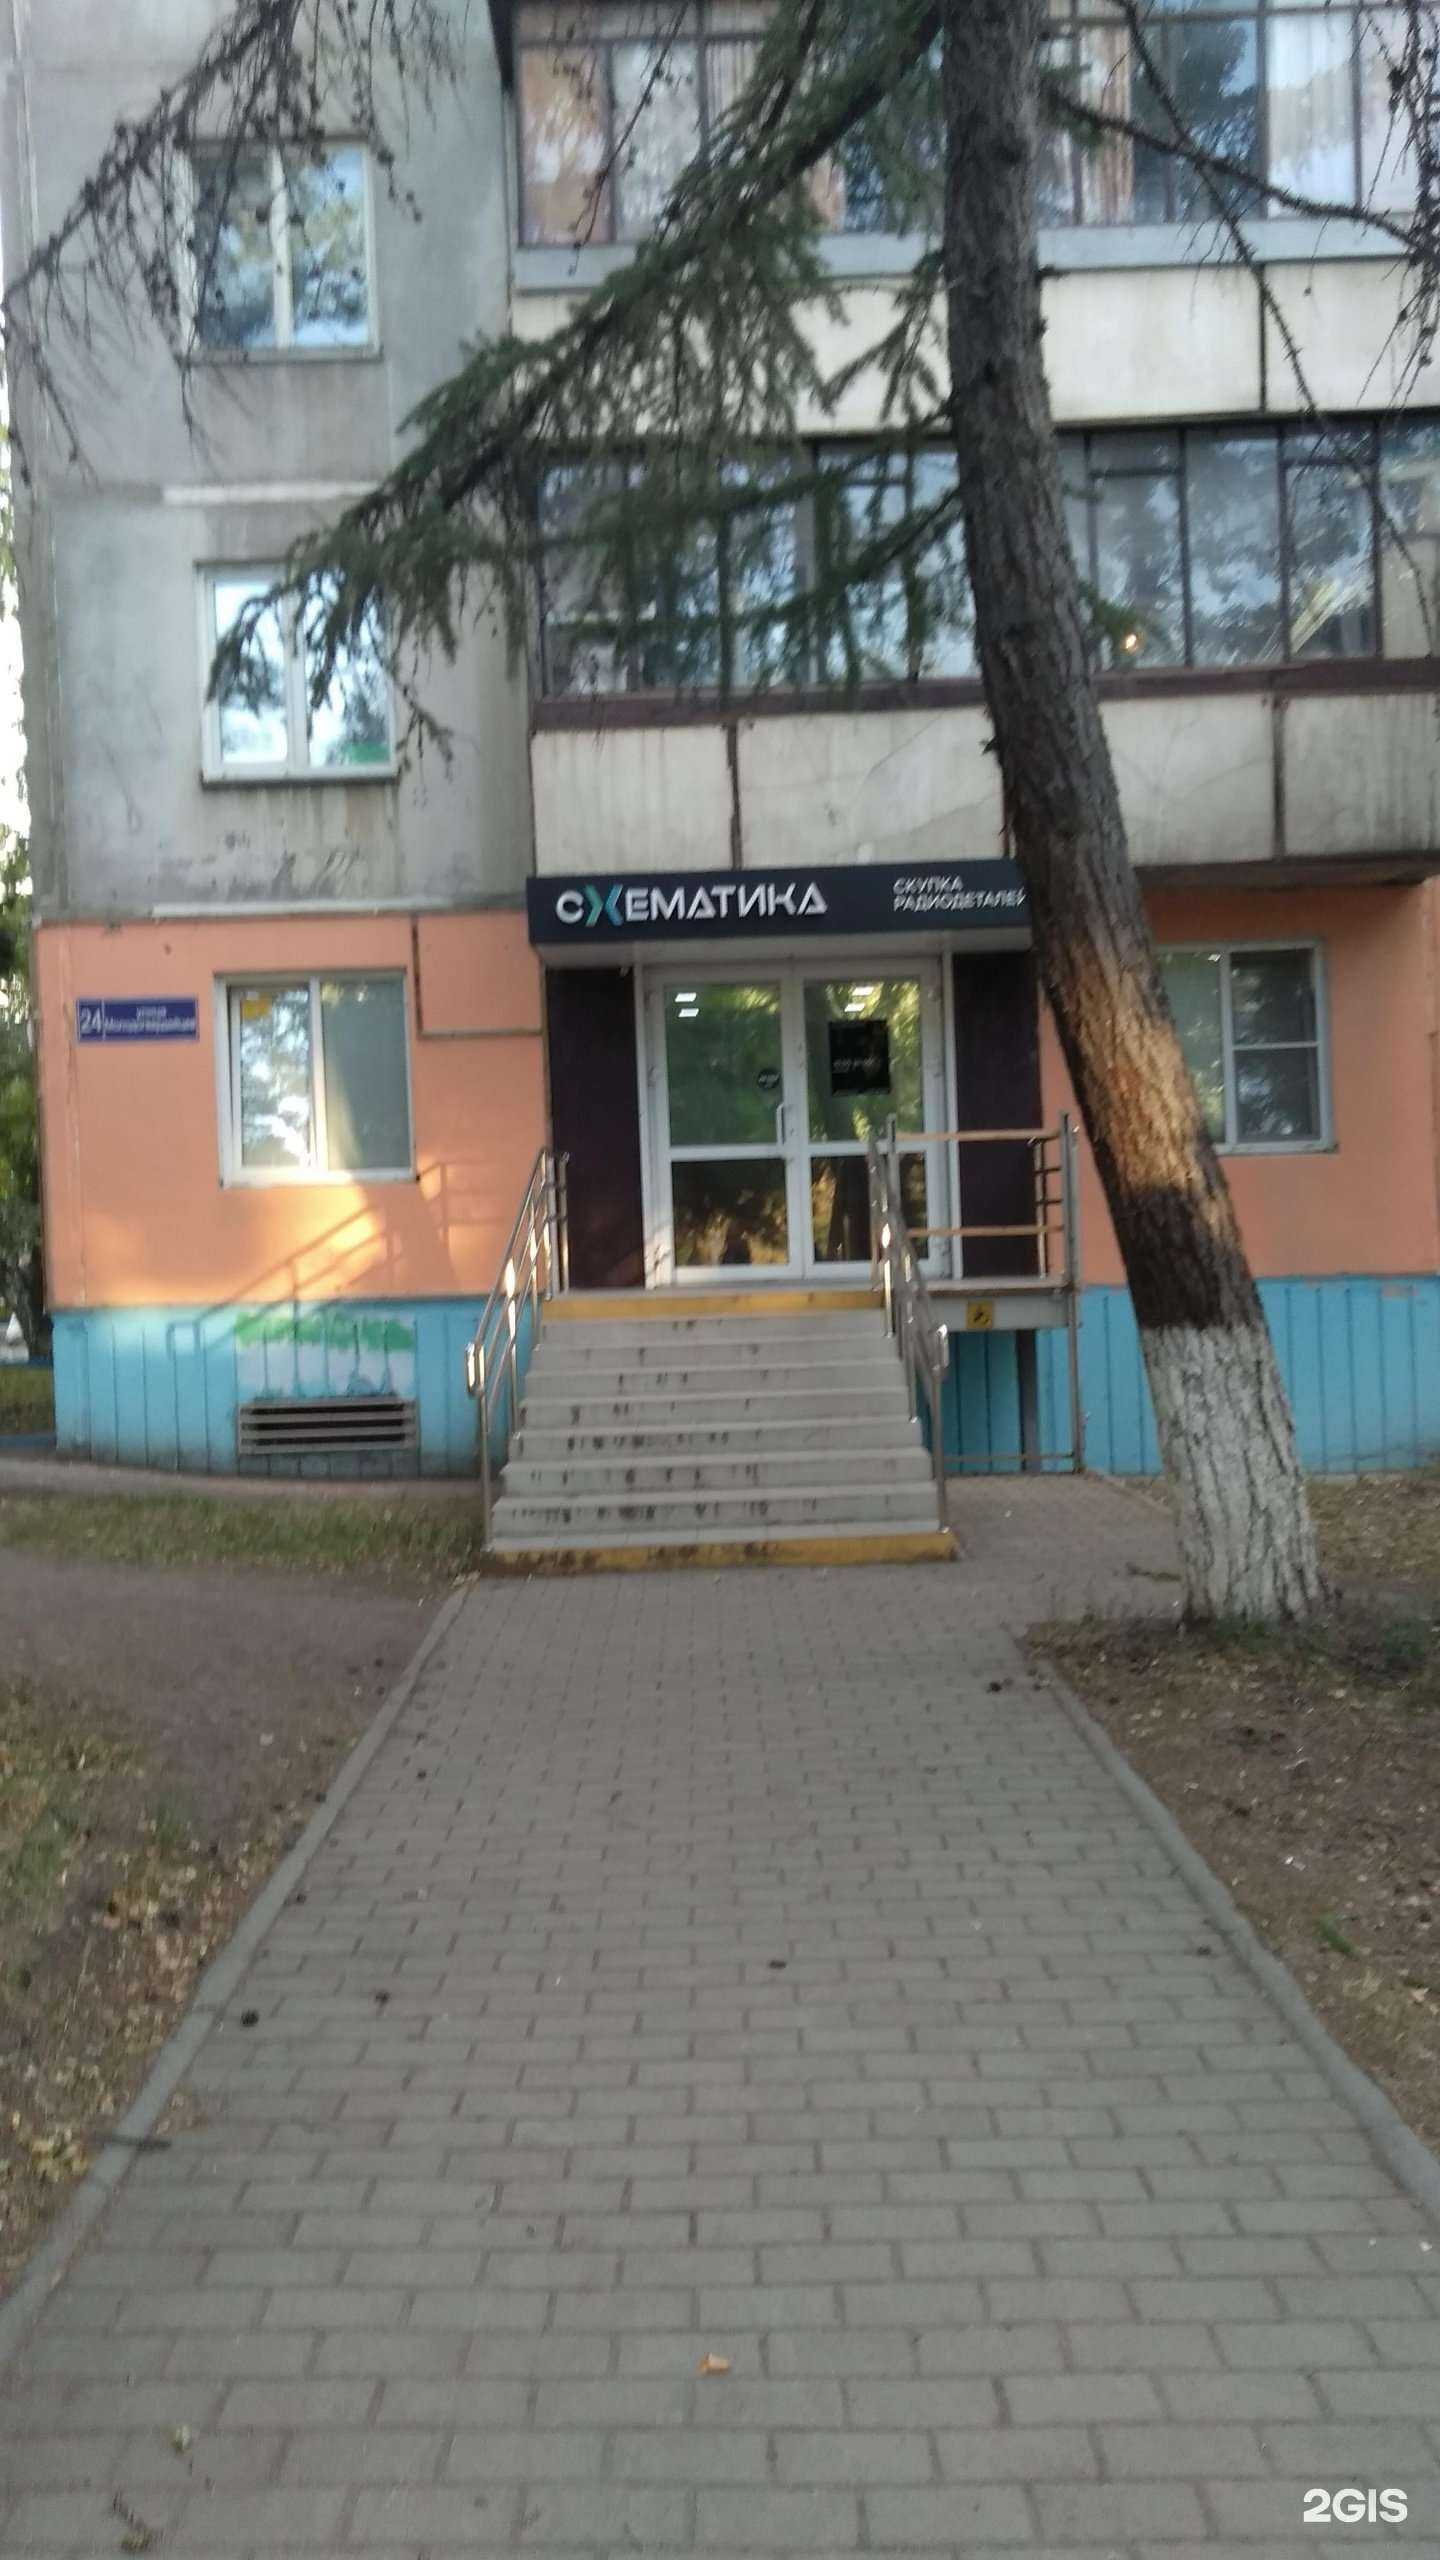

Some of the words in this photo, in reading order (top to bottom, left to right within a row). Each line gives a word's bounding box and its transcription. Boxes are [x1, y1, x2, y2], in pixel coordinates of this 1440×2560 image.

[893, 875, 963, 895] СКУПКА
[556, 882, 828, 927] СХЕМАТИКА
[80, 1007, 101, 1034] 24
